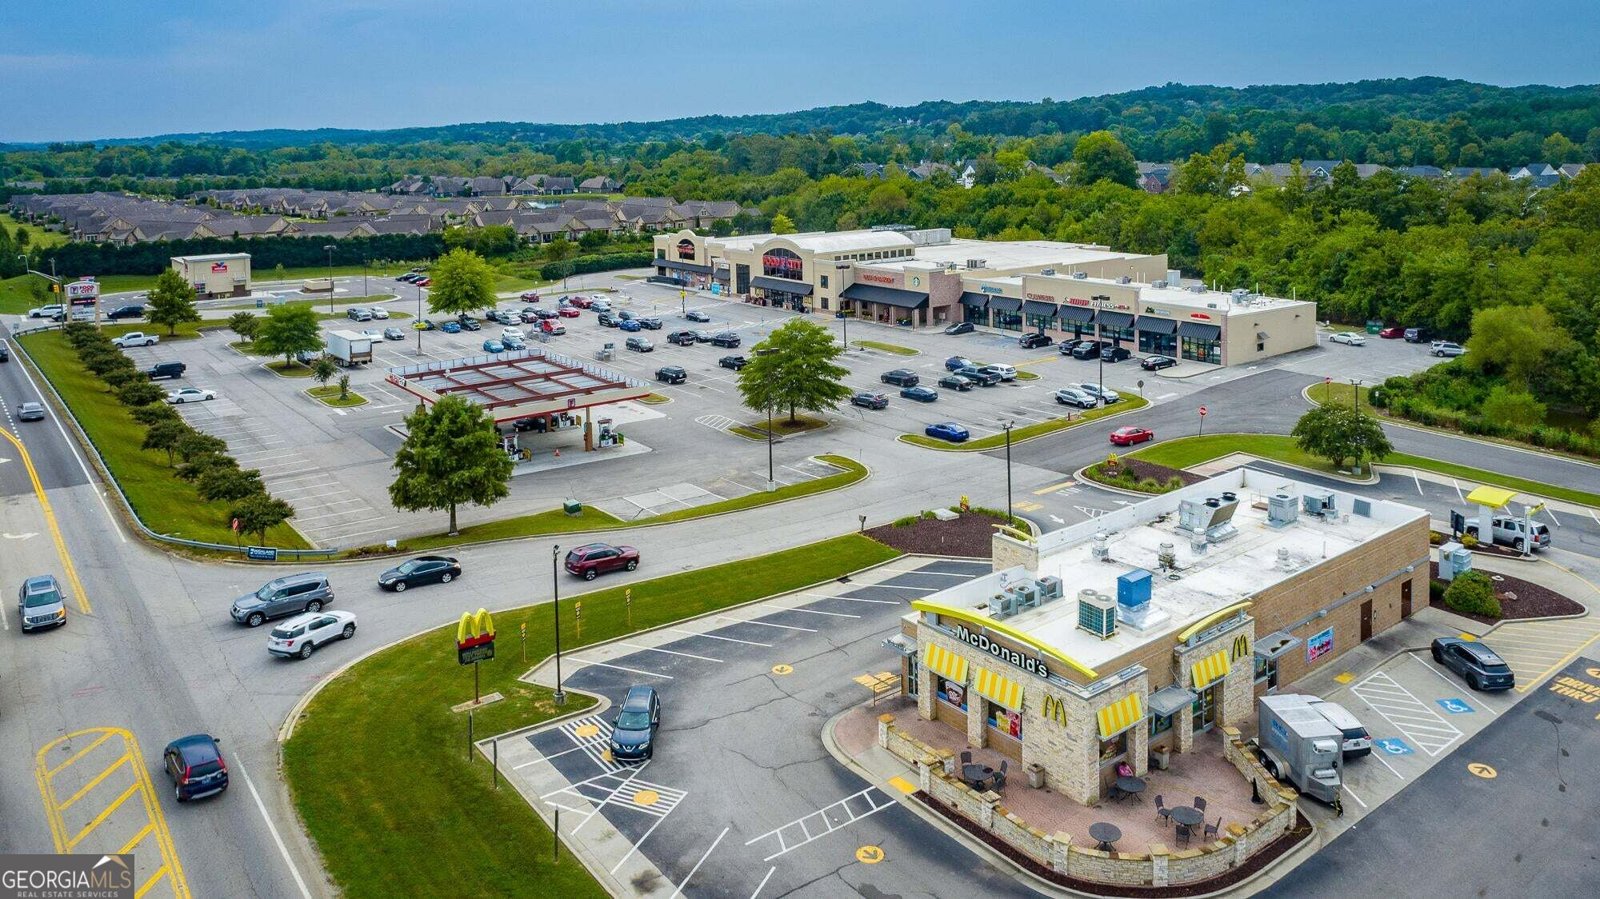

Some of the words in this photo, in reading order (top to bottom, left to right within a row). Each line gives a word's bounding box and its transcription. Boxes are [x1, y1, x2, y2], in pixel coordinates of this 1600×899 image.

[787, 258, 802, 270] CITY
[956, 624, 1049, 679] McDonald's
[1549, 684, 1599, 703] THRU
